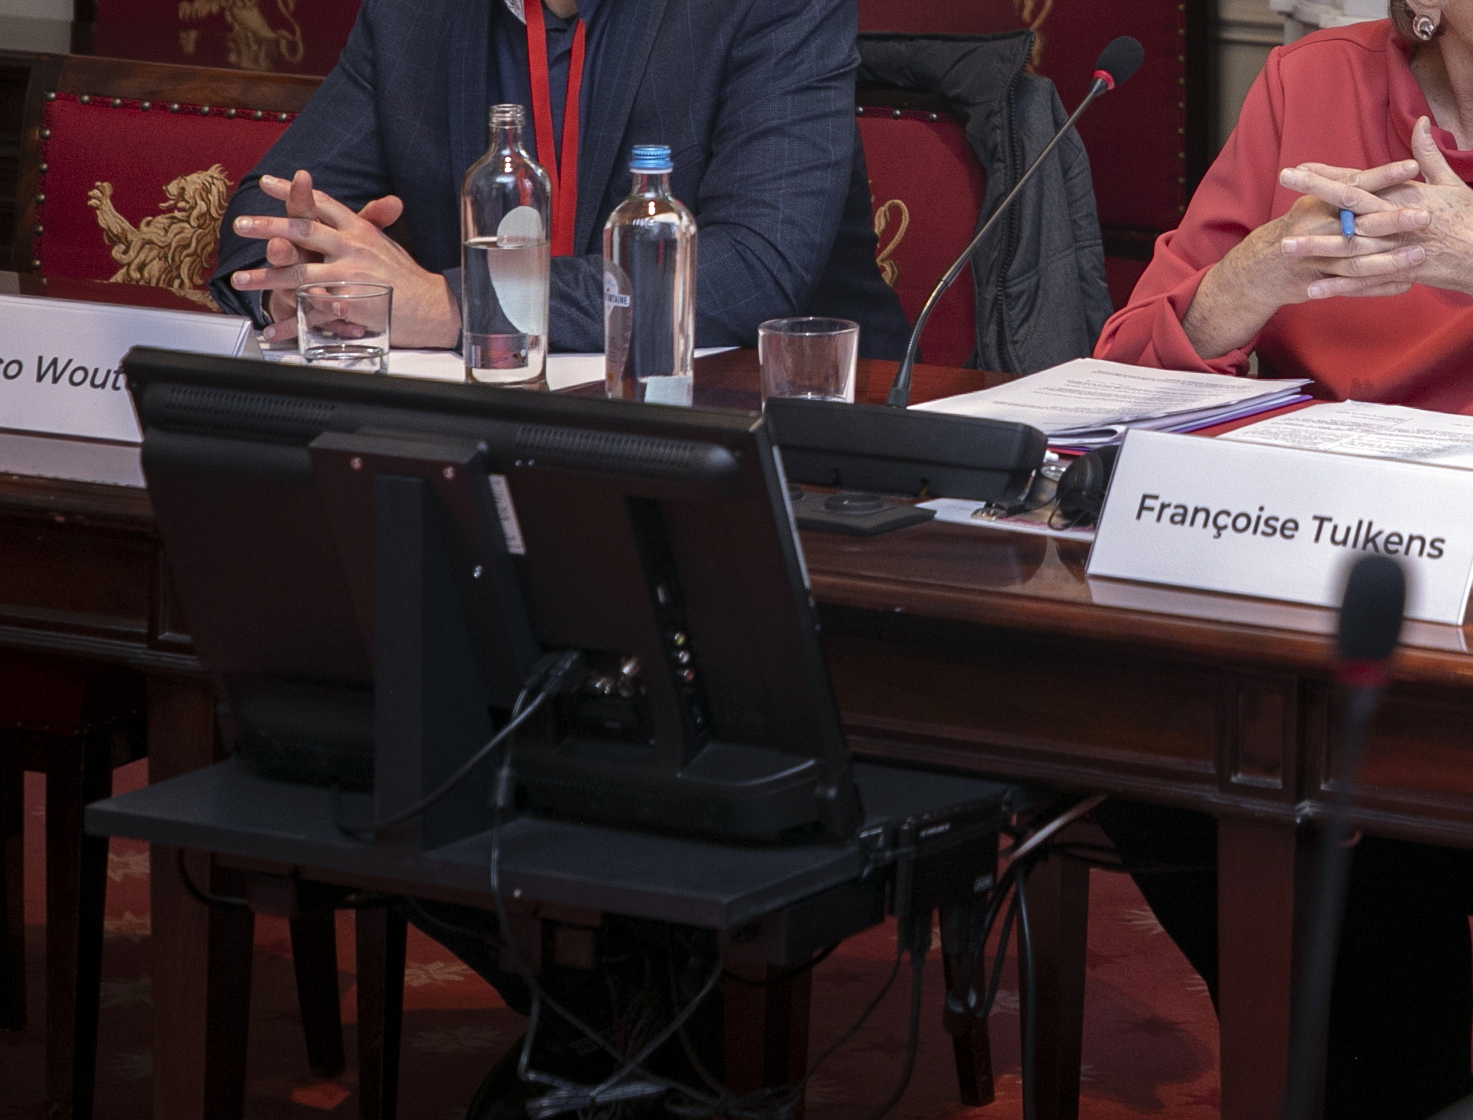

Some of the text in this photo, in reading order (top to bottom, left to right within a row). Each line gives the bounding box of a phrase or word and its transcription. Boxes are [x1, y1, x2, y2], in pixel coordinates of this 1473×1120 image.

[0, 355, 124, 391] o Wout
[1135, 493, 1446, 560] Françoise Tulkens
